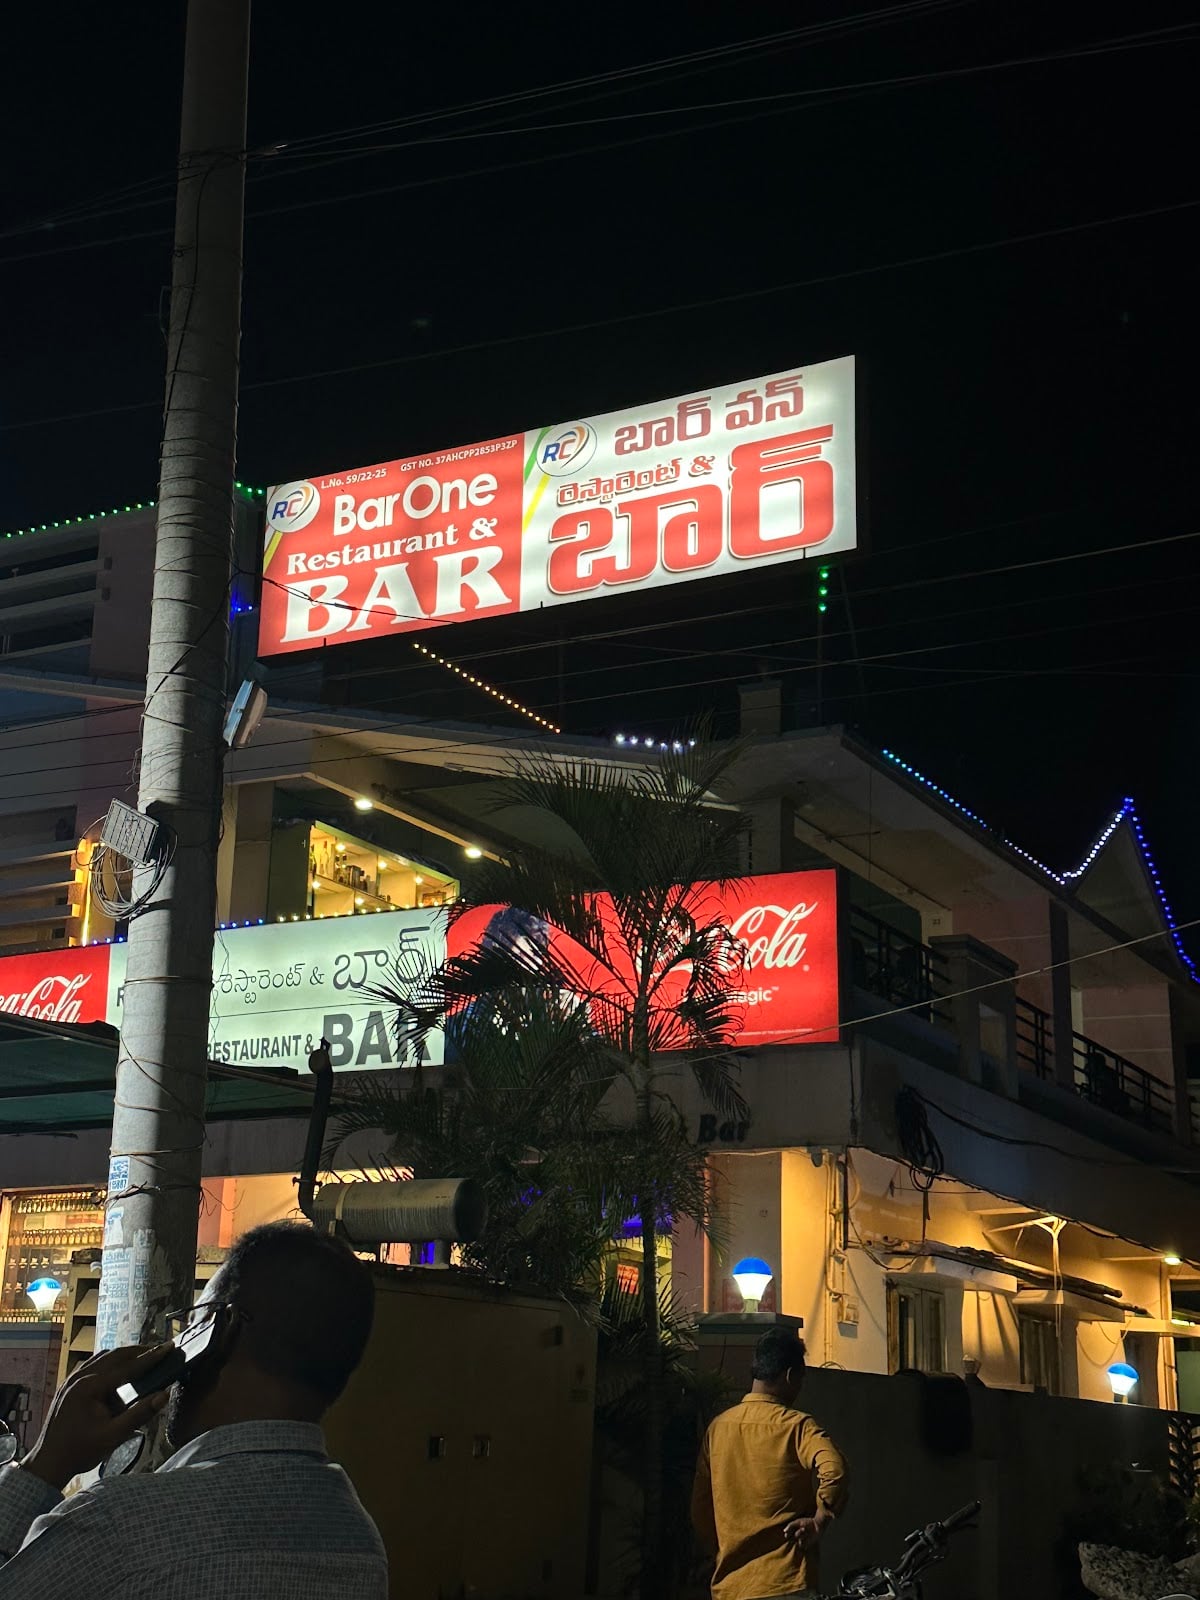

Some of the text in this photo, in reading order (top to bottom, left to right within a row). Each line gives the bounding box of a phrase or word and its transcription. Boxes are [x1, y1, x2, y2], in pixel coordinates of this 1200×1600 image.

[614, 395, 712, 457] బార్
[400, 461, 417, 472] GST
[689, 455, 715, 476] &
[548, 423, 834, 595] బార్
[287, 517, 498, 575] Restaurant &
[280, 545, 512, 643] BAR
[309, 966, 325, 985] &
[304, 1033, 314, 1055] &
